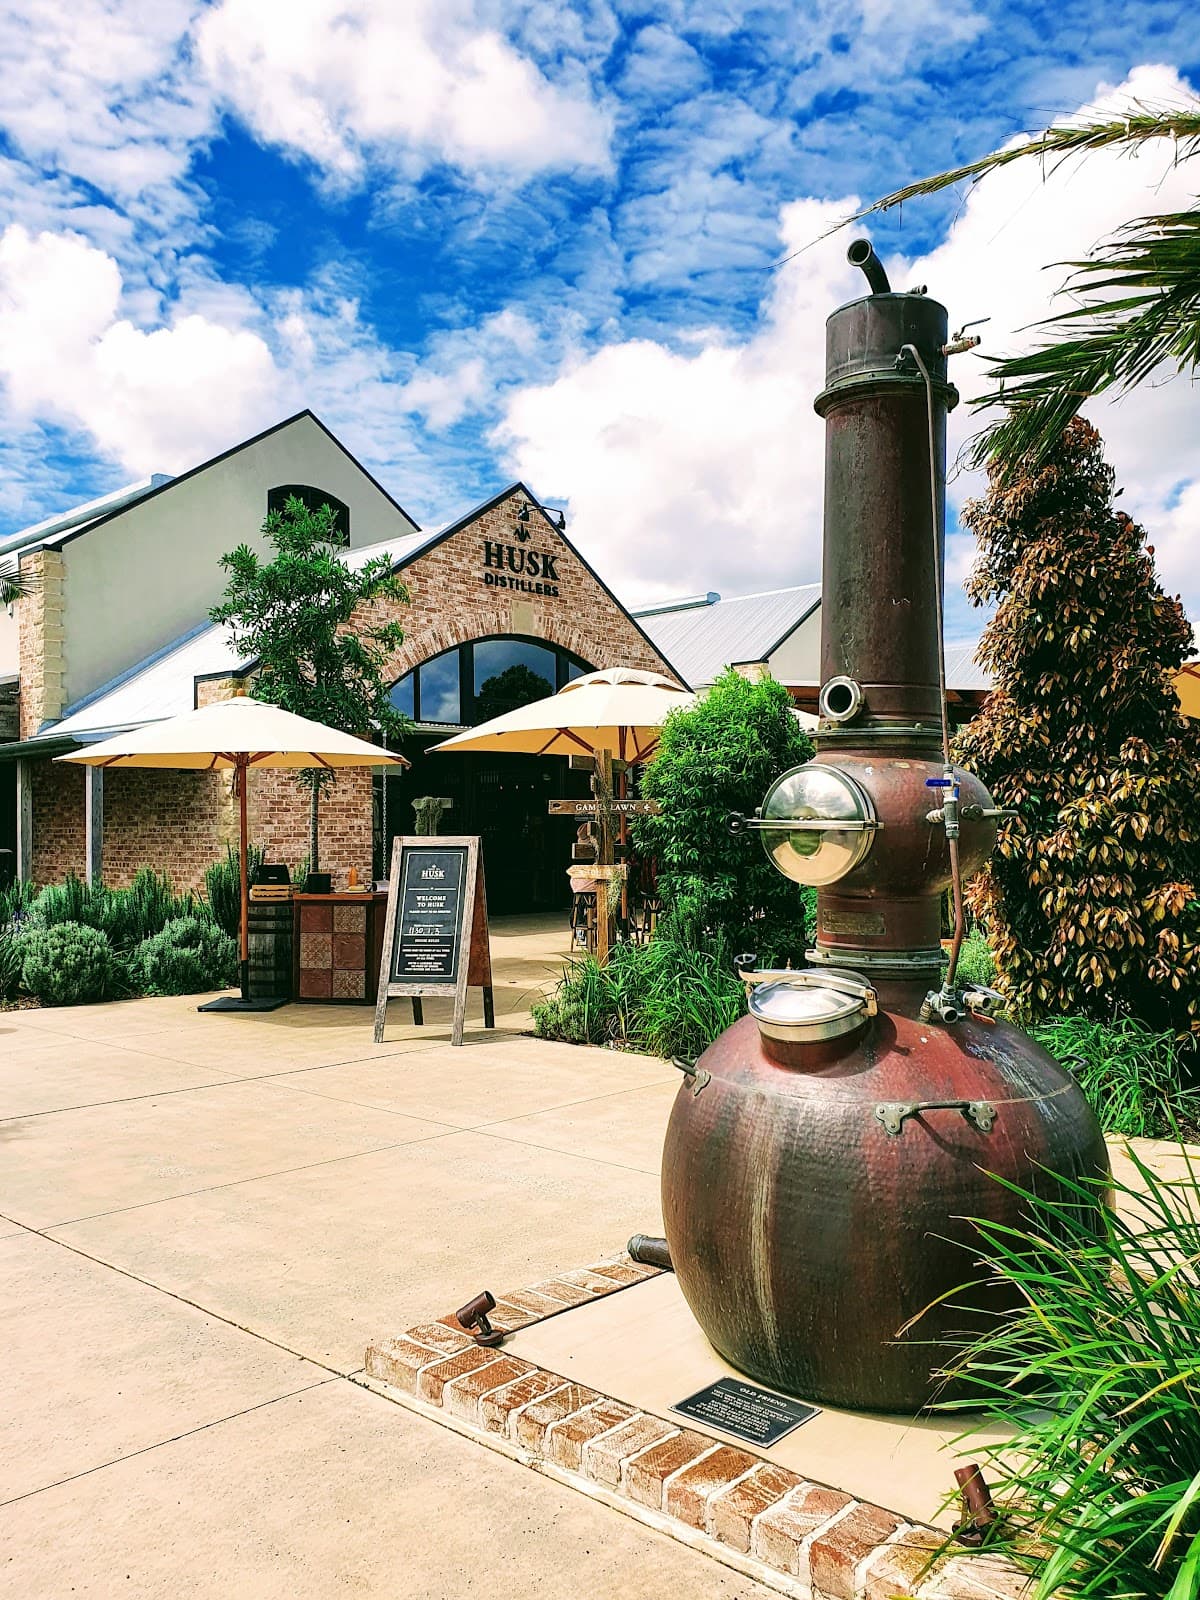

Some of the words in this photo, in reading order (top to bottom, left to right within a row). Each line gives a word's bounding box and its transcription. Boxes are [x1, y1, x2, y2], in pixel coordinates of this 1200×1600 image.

[483, 540, 560, 581] HUSK
[484, 573, 559, 597] DISTILLERS
[610, 803, 636, 811] LAWN
[421, 870, 445, 878] HUSK
[739, 1387, 757, 1397] OLD
[757, 1393, 788, 1408] FRIEND
